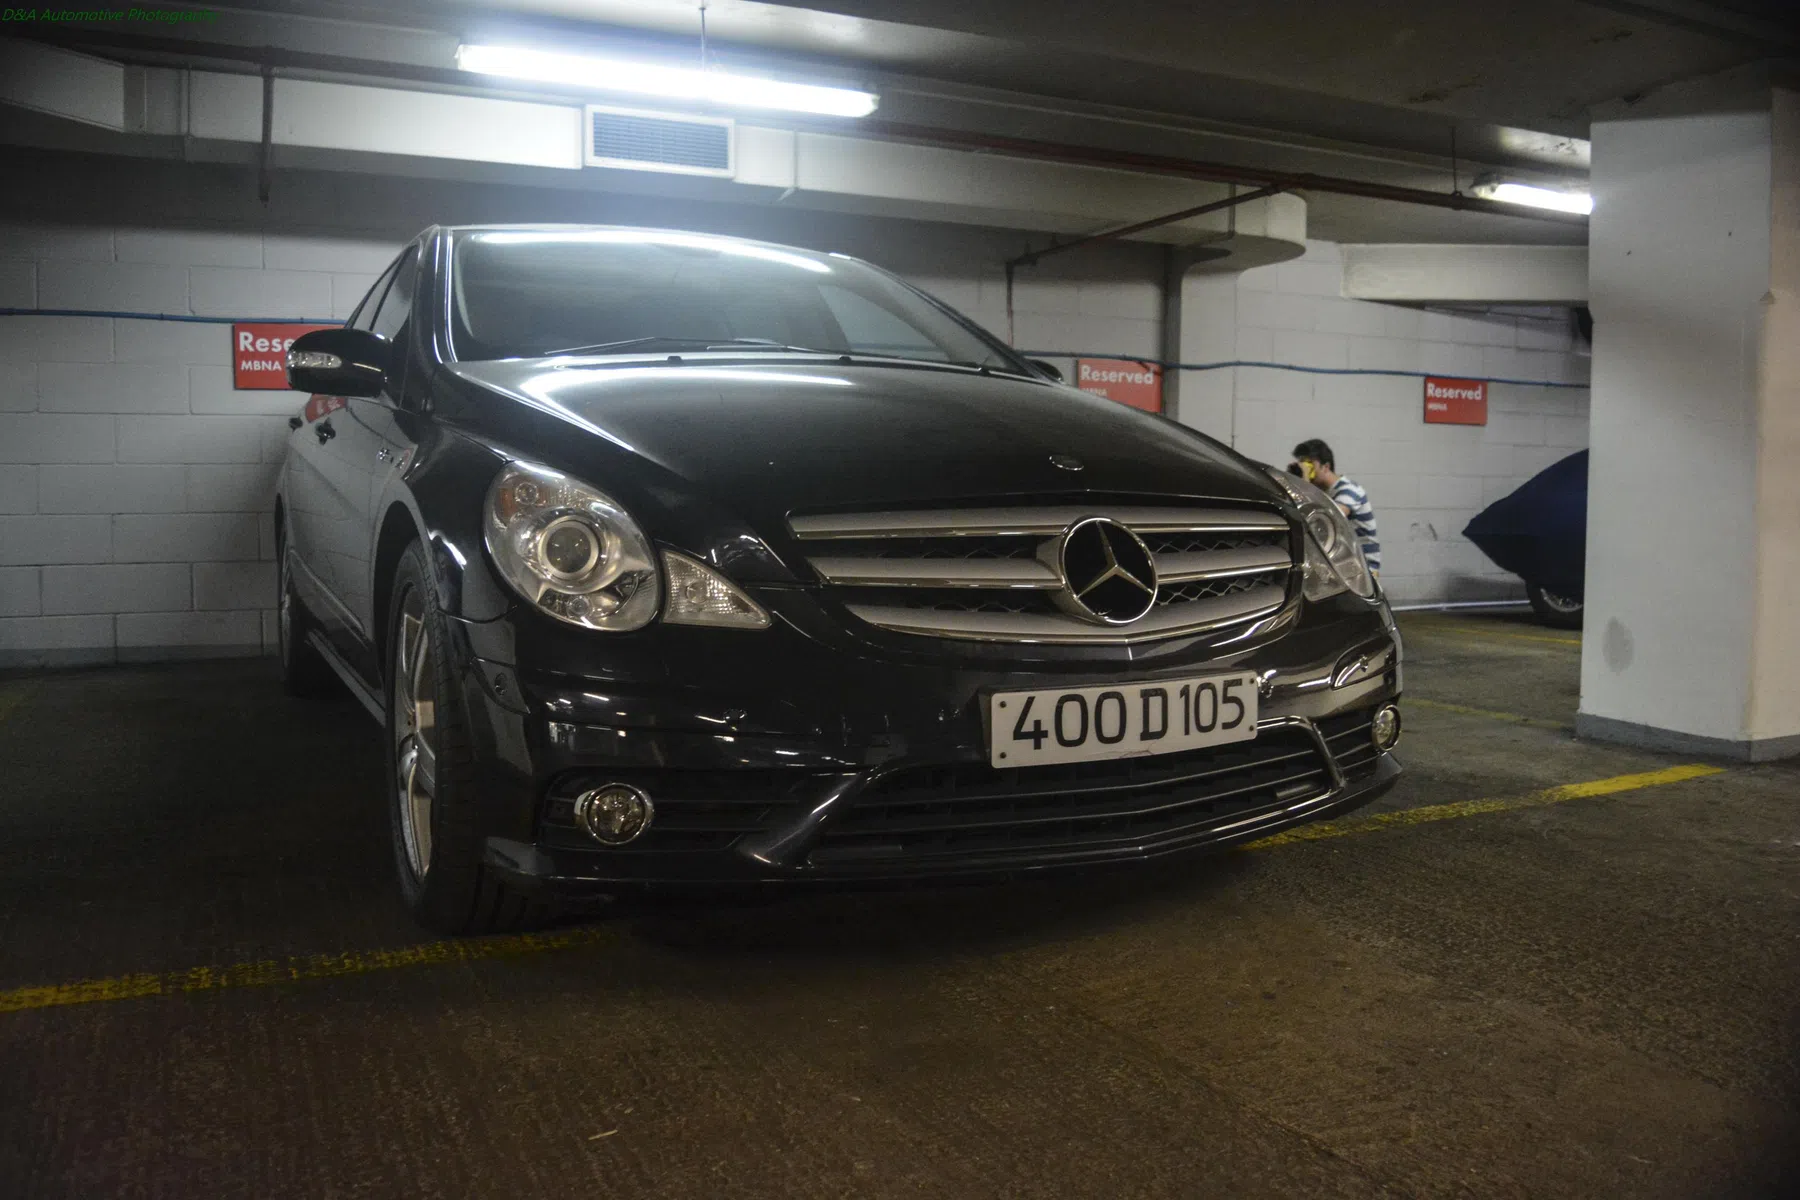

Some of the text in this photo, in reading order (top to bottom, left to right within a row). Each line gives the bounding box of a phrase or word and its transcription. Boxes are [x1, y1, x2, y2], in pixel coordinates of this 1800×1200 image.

[239, 331, 294, 353] Rese
[241, 360, 282, 371] MBNA
[1081, 364, 1154, 385] Reserved
[1427, 383, 1482, 400] Reserved
[1012, 691, 1127, 750] 400
